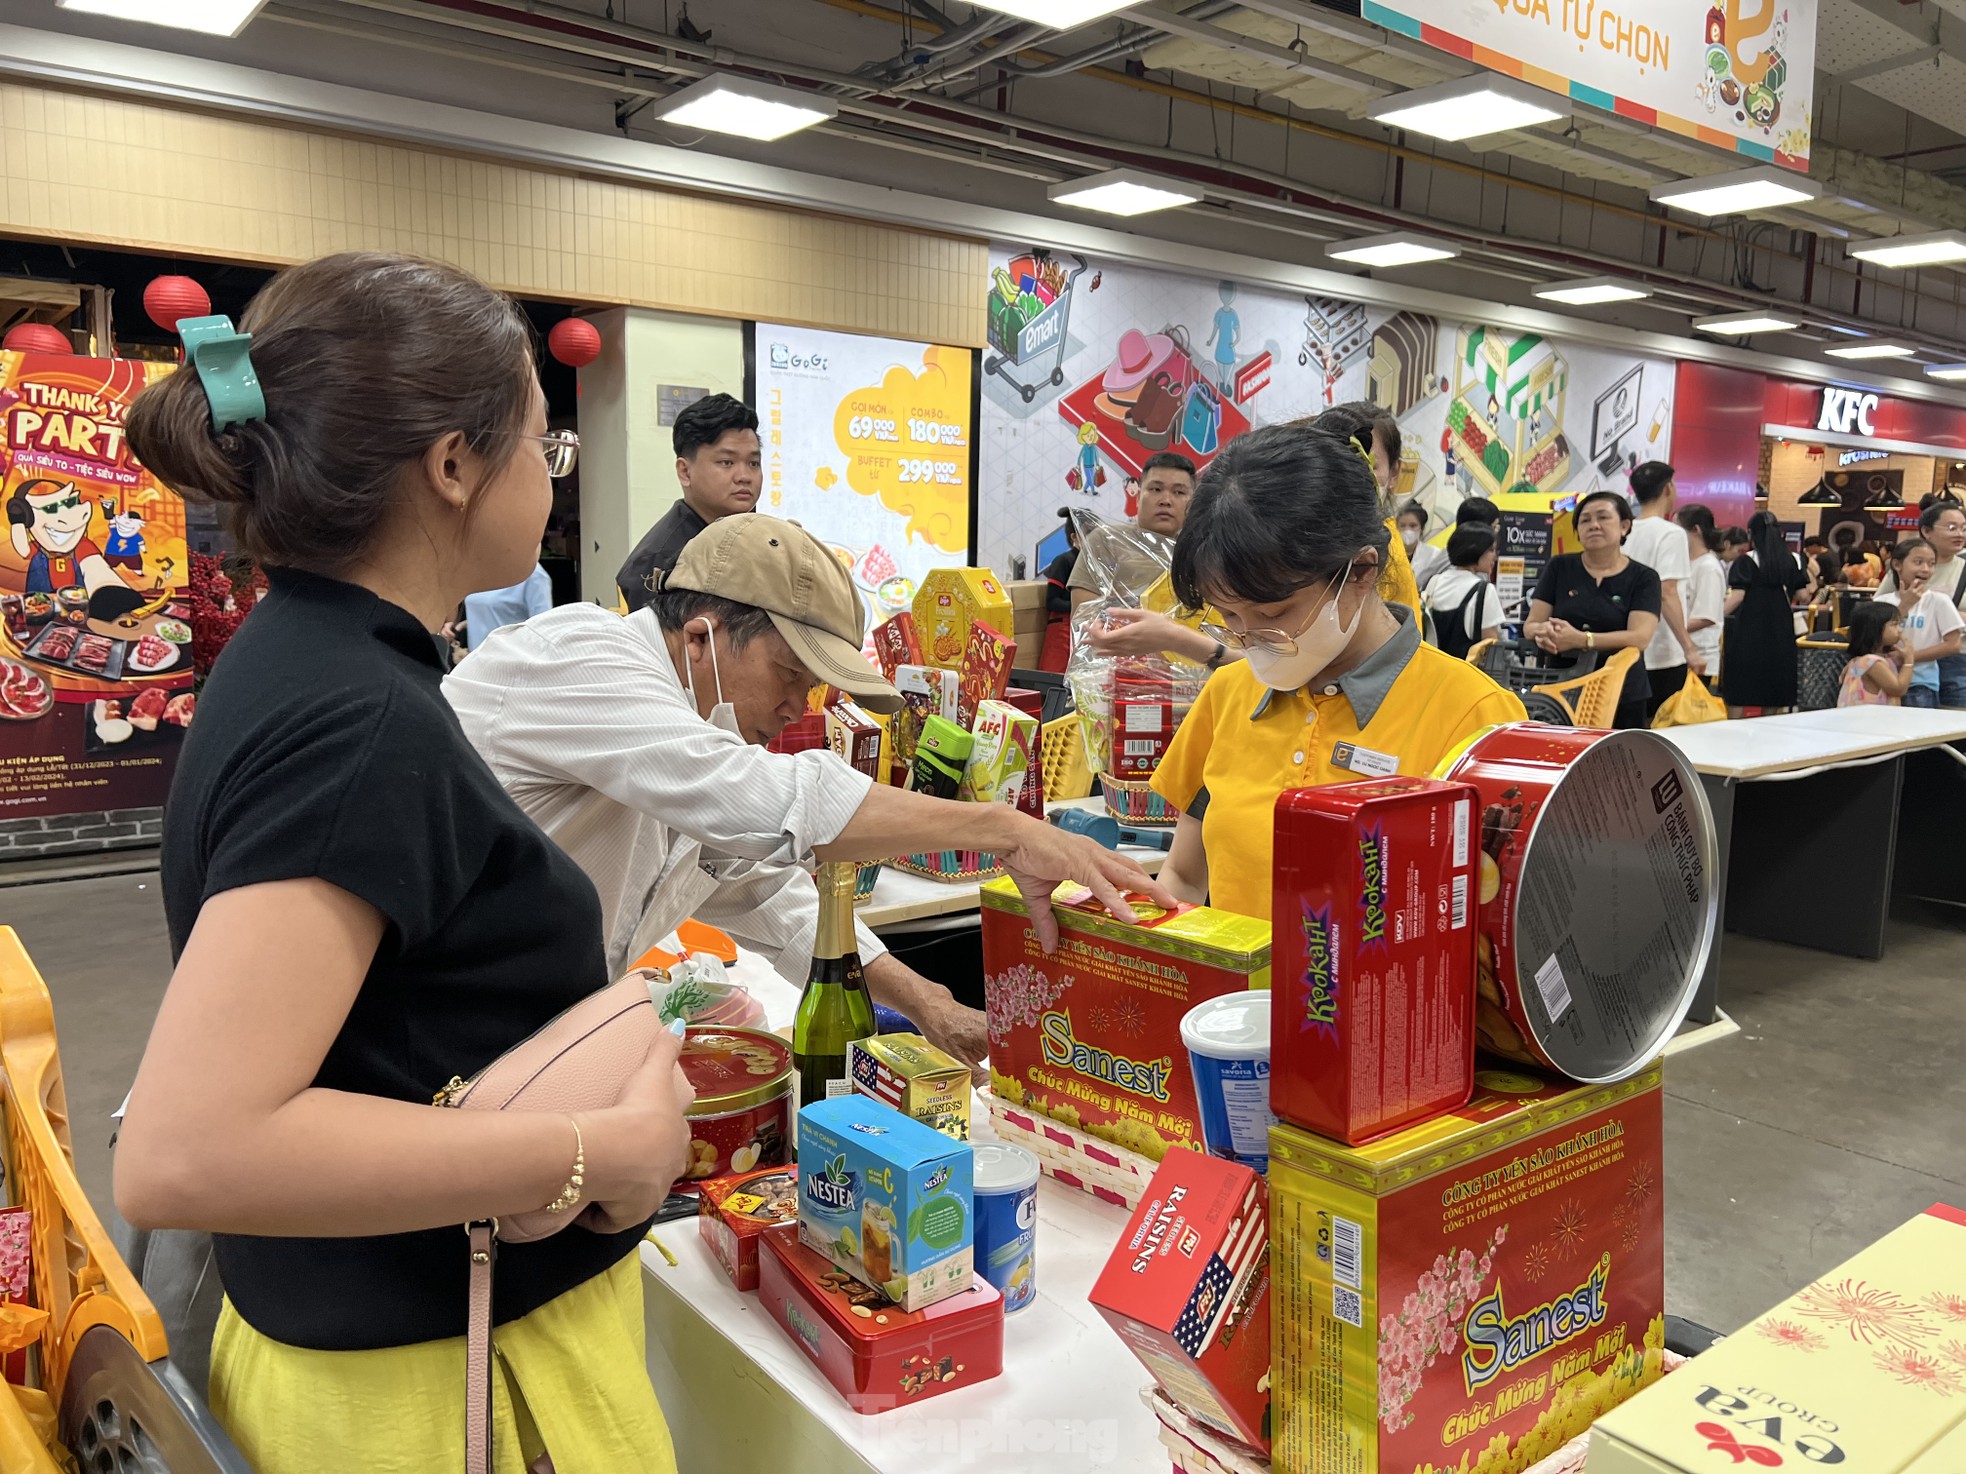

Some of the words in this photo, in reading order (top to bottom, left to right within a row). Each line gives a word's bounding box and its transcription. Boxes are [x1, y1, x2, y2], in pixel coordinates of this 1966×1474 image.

[1599, 10, 1670, 76] CHỌN
[1025, 308, 1060, 353] emart
[23, 382, 100, 413] THANK
[911, 407, 944, 419] COMBO
[1817, 387, 1880, 436] KFC
[848, 415, 874, 440] 69
[906, 418, 941, 444] 180
[1603, 427, 1613, 441] No
[1614, 407, 1634, 431] Brand
[17, 453, 34, 463] QUÀ
[36, 454, 53, 467] SIÊU
[55, 459, 68, 470] TO
[75, 462, 94, 477] TIỆC
[96, 467, 114, 480] SIÊU
[115, 472, 137, 483] WOW
[857, 455, 892, 468] BUFFET
[898, 458, 935, 484] 299
[978, 720, 1001, 736] AFC
[1673, 802, 1690, 837] BÁNH
[1684, 835, 1698, 859] QUY
[1664, 813, 1681, 848] CÔNG
[1673, 842, 1690, 879] THỨC
[1684, 872, 1699, 904] PHÁP
[1396, 913, 1404, 941] KDV
[1071, 939, 1093, 957] YẾN
[1093, 944, 1116, 963] SÀO
[1117, 951, 1160, 977] KHÁNH
[1161, 965, 1189, 984] HÒA
[1125, 975, 1149, 990] SANEST
[1040, 1006, 1174, 1103] Sanest
[916, 1100, 963, 1118] RAISINS
[926, 1095, 953, 1105] SEEDLESS
[1028, 1065, 1065, 1093] Chúc
[1066, 1078, 1112, 1111] Mừng
[1114, 1096, 1156, 1125] Năm
[1157, 1110, 1194, 1139] Mới
[884, 1167, 894, 1194] C
[924, 1173, 948, 1191] NESTEA
[1442, 1176, 1482, 1207] CÔNG
[1482, 1168, 1503, 1190] TY
[1502, 1156, 1530, 1183] YẾN
[1530, 1147, 1555, 1171] SÀO
[1556, 1132, 1598, 1161] KHÁNH
[1599, 1119, 1625, 1142] HÒA
[1443, 1205, 1465, 1221] CÔNG
[1465, 1201, 1476, 1213] TY
[1611, 1139, 1625, 1152] HÒA
[807, 1173, 856, 1211] NESTEA
[1443, 1218, 1465, 1234] CÔNG
[1465, 1213, 1476, 1226] TY
[1564, 1164, 1589, 1184] SANEST
[1611, 1150, 1625, 1164] HÒA
[1129, 1200, 1161, 1250] CALIFORNIA
[1130, 1184, 1188, 1275] RAISINS
[1158, 1216, 1186, 1256] SEEDLESS
[1459, 1261, 1611, 1398] Sanest
[1441, 1405, 1492, 1448] Chúc
[1493, 1369, 1548, 1424] Mừng
[1549, 1349, 1592, 1394] Năm
[1592, 1322, 1628, 1366] Mới
[1694, 1385, 1846, 1465] eva
[1738, 1386, 1839, 1434] GROUP
